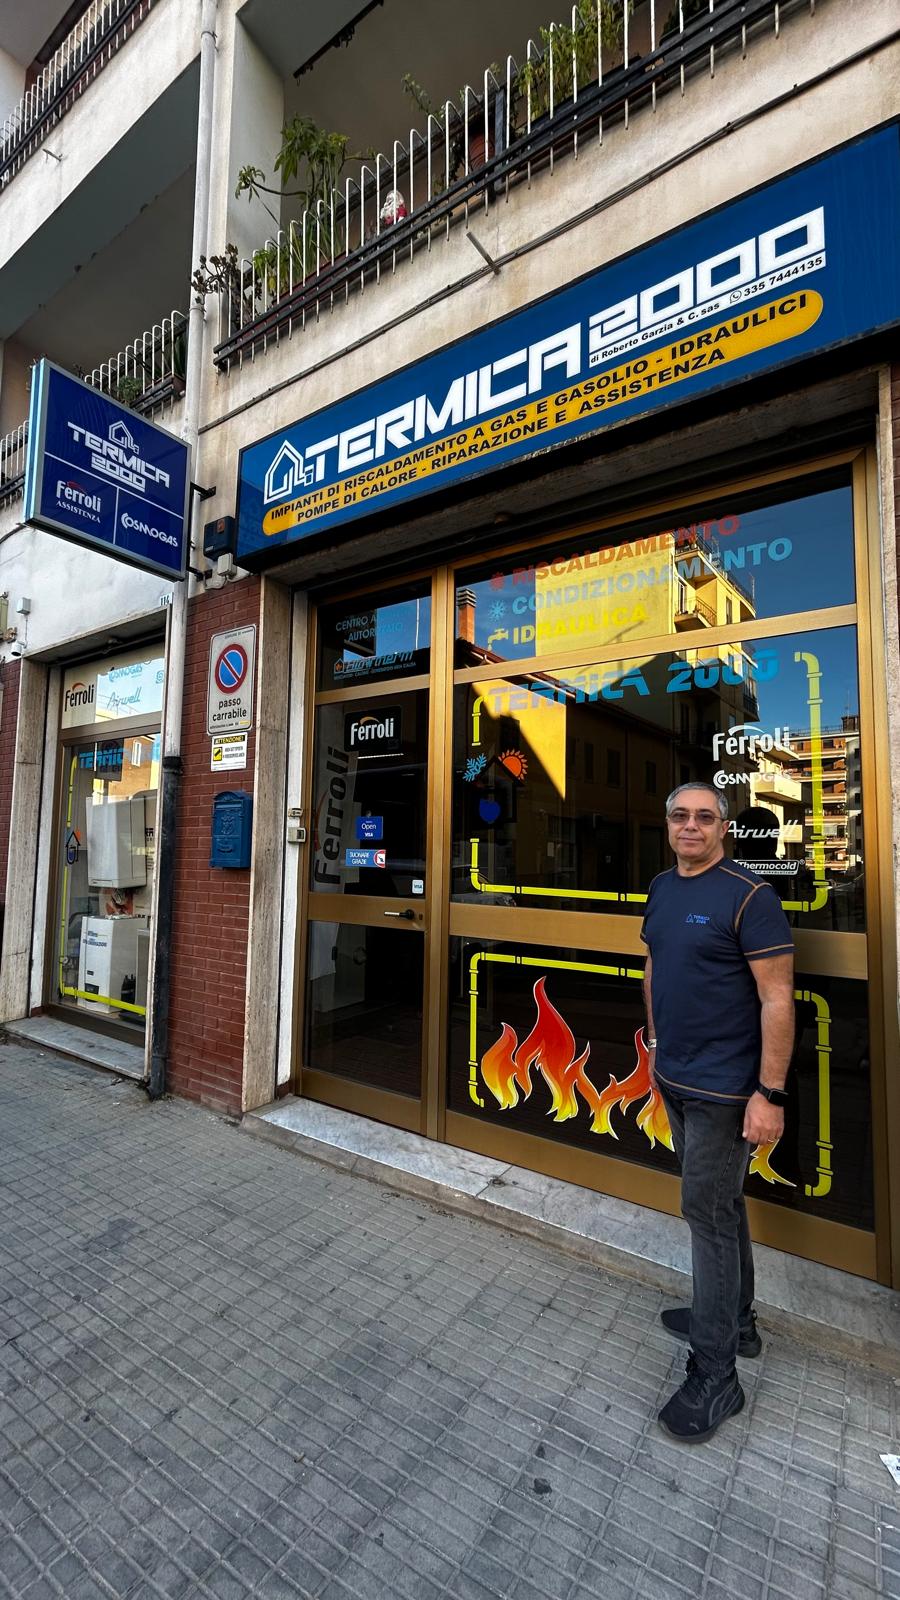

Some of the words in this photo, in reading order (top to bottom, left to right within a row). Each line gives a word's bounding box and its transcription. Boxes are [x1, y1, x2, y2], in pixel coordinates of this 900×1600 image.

[590, 352, 601, 364] di
[601, 337, 639, 360] Roberto
[641, 322, 674, 343] Garzia
[676, 317, 685, 325] &
[687, 312, 699, 322] C.
[700, 302, 720, 316] sas
[743, 282, 766, 297] 335
[769, 257, 823, 286] 7444135
[305, 322, 582, 482] TERMICA
[588, 206, 826, 353] 2000
[270, 492, 324, 520] IMPIANTI
[327, 484, 340, 497] DI
[345, 434, 468, 490] RISCALDAMENTO
[473, 426, 484, 437] A
[490, 409, 528, 432] GAS
[536, 400, 548, 415] E
[554, 361, 648, 407] GASOLIO
[670, 293, 807, 360] IDRAULICI
[297, 499, 340, 523] POMPE
[343, 492, 357, 505] DI
[360, 472, 417, 499] CALORE
[431, 418, 548, 470] RIPARAZIONE
[555, 409, 567, 424] E
[579, 348, 725, 414] ASSISTENZA
[67, 421, 170, 489] TERMICA
[91, 452, 145, 493] 2000
[55, 499, 101, 524] ASSISTENZA
[56, 480, 102, 513] Ferroli
[120, 512, 179, 547] COSMOGAS
[512, 514, 740, 587] RISCALDAMENTO
[511, 537, 793, 615] CONDIZIONAMENTO
[335, 616, 368, 632] CENTRO
[513, 601, 649, 645] IDRAULICA
[488, 667, 650, 712] TERMICA
[666, 648, 781, 693] 2000
[64, 684, 95, 712] Ferroli
[106, 686, 142, 710] Airwell
[212, 707, 247, 722] carrabile
[218, 697, 241, 710] passo
[349, 717, 395, 745] Ferroli
[712, 726, 792, 762] Ferroli
[713, 769, 794, 789] COSMOGS
[314, 745, 350, 886] Ferroli
[361, 823, 377, 831] Open
[727, 819, 799, 839] Airwell
[737, 861, 797, 870] Thermocold
